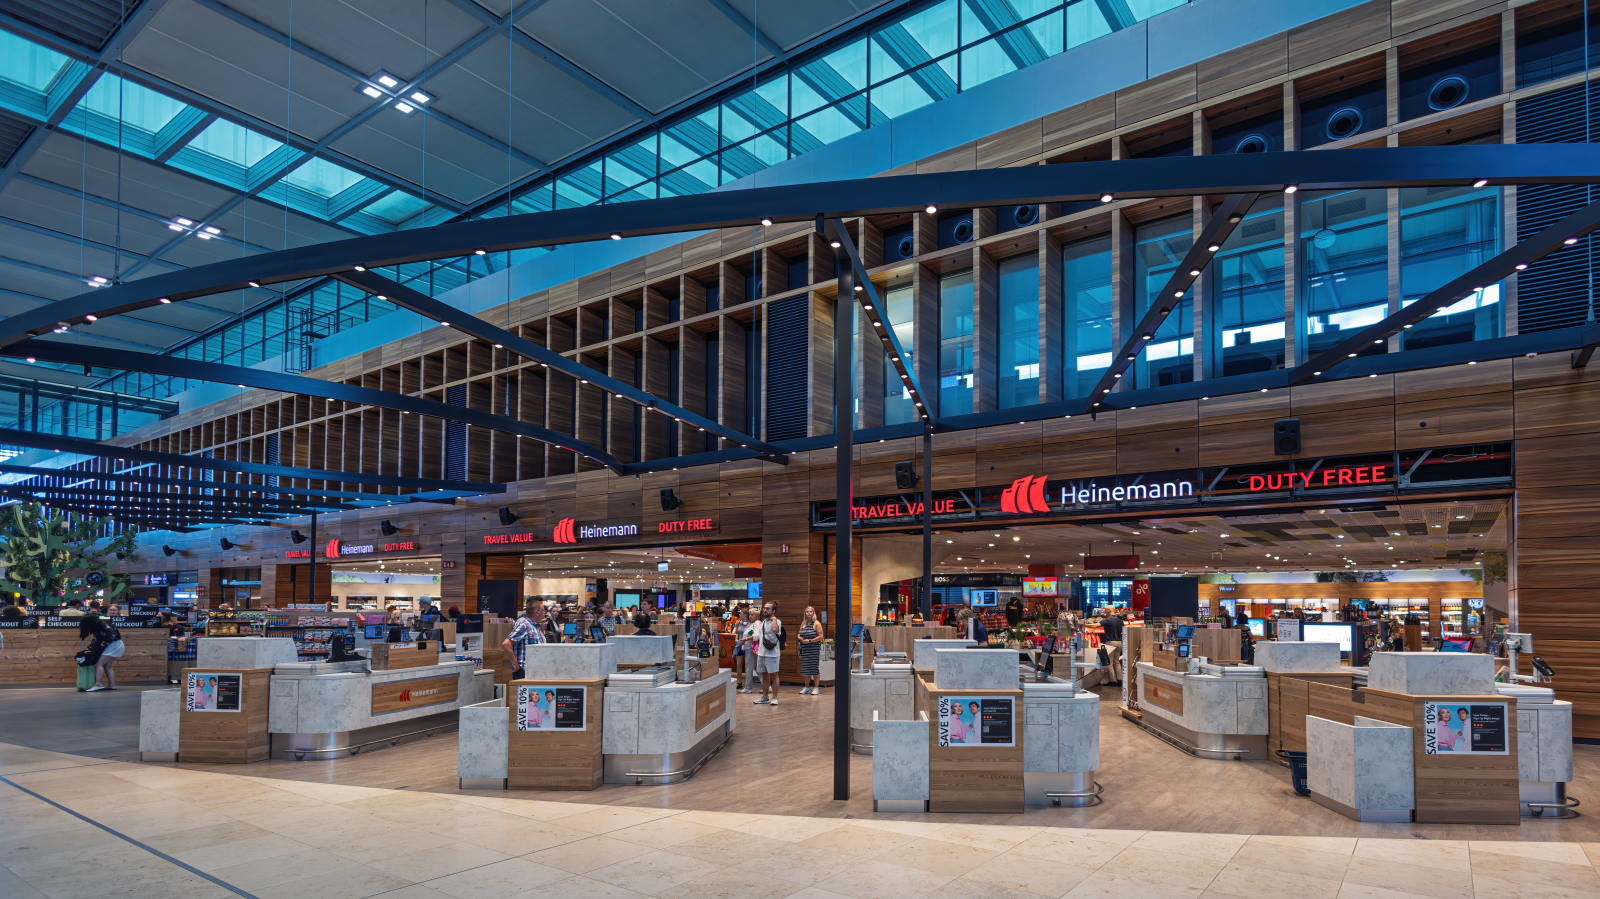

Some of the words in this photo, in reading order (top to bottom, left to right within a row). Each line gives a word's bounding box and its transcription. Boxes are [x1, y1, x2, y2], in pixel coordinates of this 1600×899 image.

[1250, 471, 1315, 491] DUTY
[1323, 466, 1386, 486] FREE
[1061, 481, 1193, 505] Heinemann
[852, 504, 902, 519] TRAVEL
[580, 524, 637, 539] Heinemann
[659, 520, 685, 533] DUTY
[687, 519, 712, 531] FREE
[484, 535, 508, 544] TRAVEL
[510, 533, 534, 543] VALUE
[285, 550, 301, 558] TRAVEL
[341, 544, 373, 555] Heinemann
[384, 543, 399, 552] DUTY
[400, 542, 414, 550] FREE
[411, 688, 439, 698] Heinemann
[187, 691, 196, 712] SAVE
[518, 707, 527, 731] SAVE
[940, 721, 949, 747] SAVE
[1426, 728, 1437, 754] SAVE
